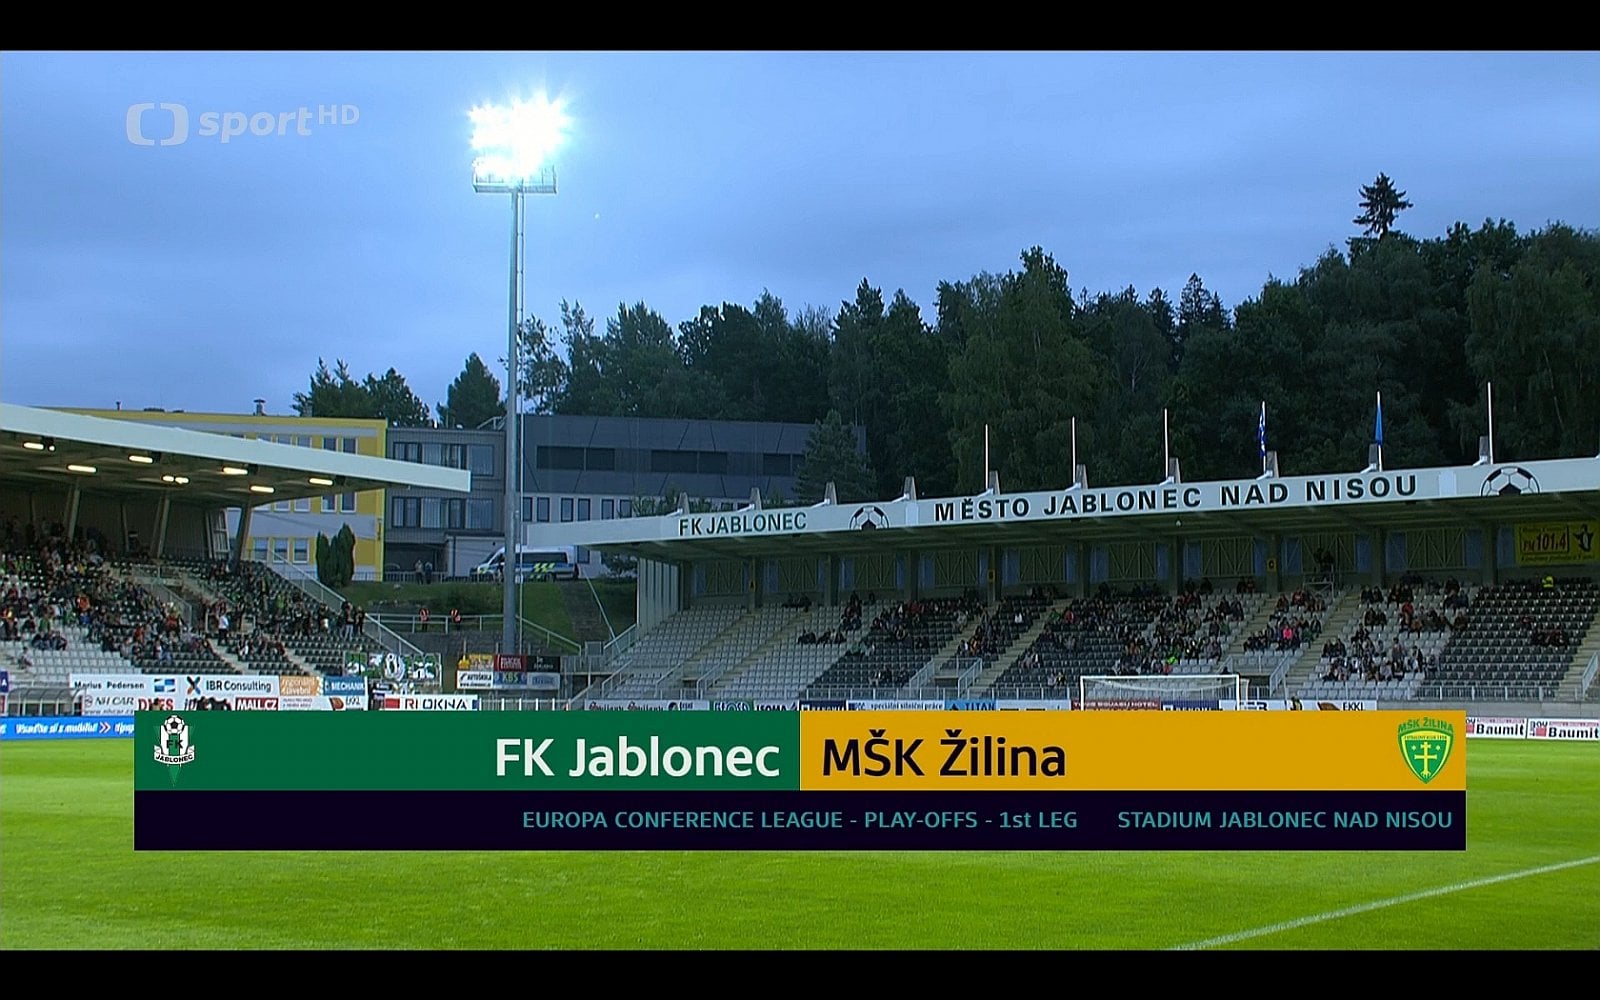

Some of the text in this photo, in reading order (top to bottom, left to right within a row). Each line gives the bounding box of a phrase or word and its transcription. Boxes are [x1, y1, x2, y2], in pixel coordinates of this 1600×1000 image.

[934, 475, 1416, 521] MĚSTO JABLONEC NAD NISOU
[679, 512, 807, 536] FK JABLONEC
[74, 681, 145, 689] Marius Pedersen
[206, 680, 223, 690] IBR
[224, 680, 272, 692] Consulting
[114, 697, 134, 705] CAR
[405, 698, 467, 709] RI OKNA
[1476, 724, 1524, 735] Baumit
[1548, 727, 1600, 738] Baumit
